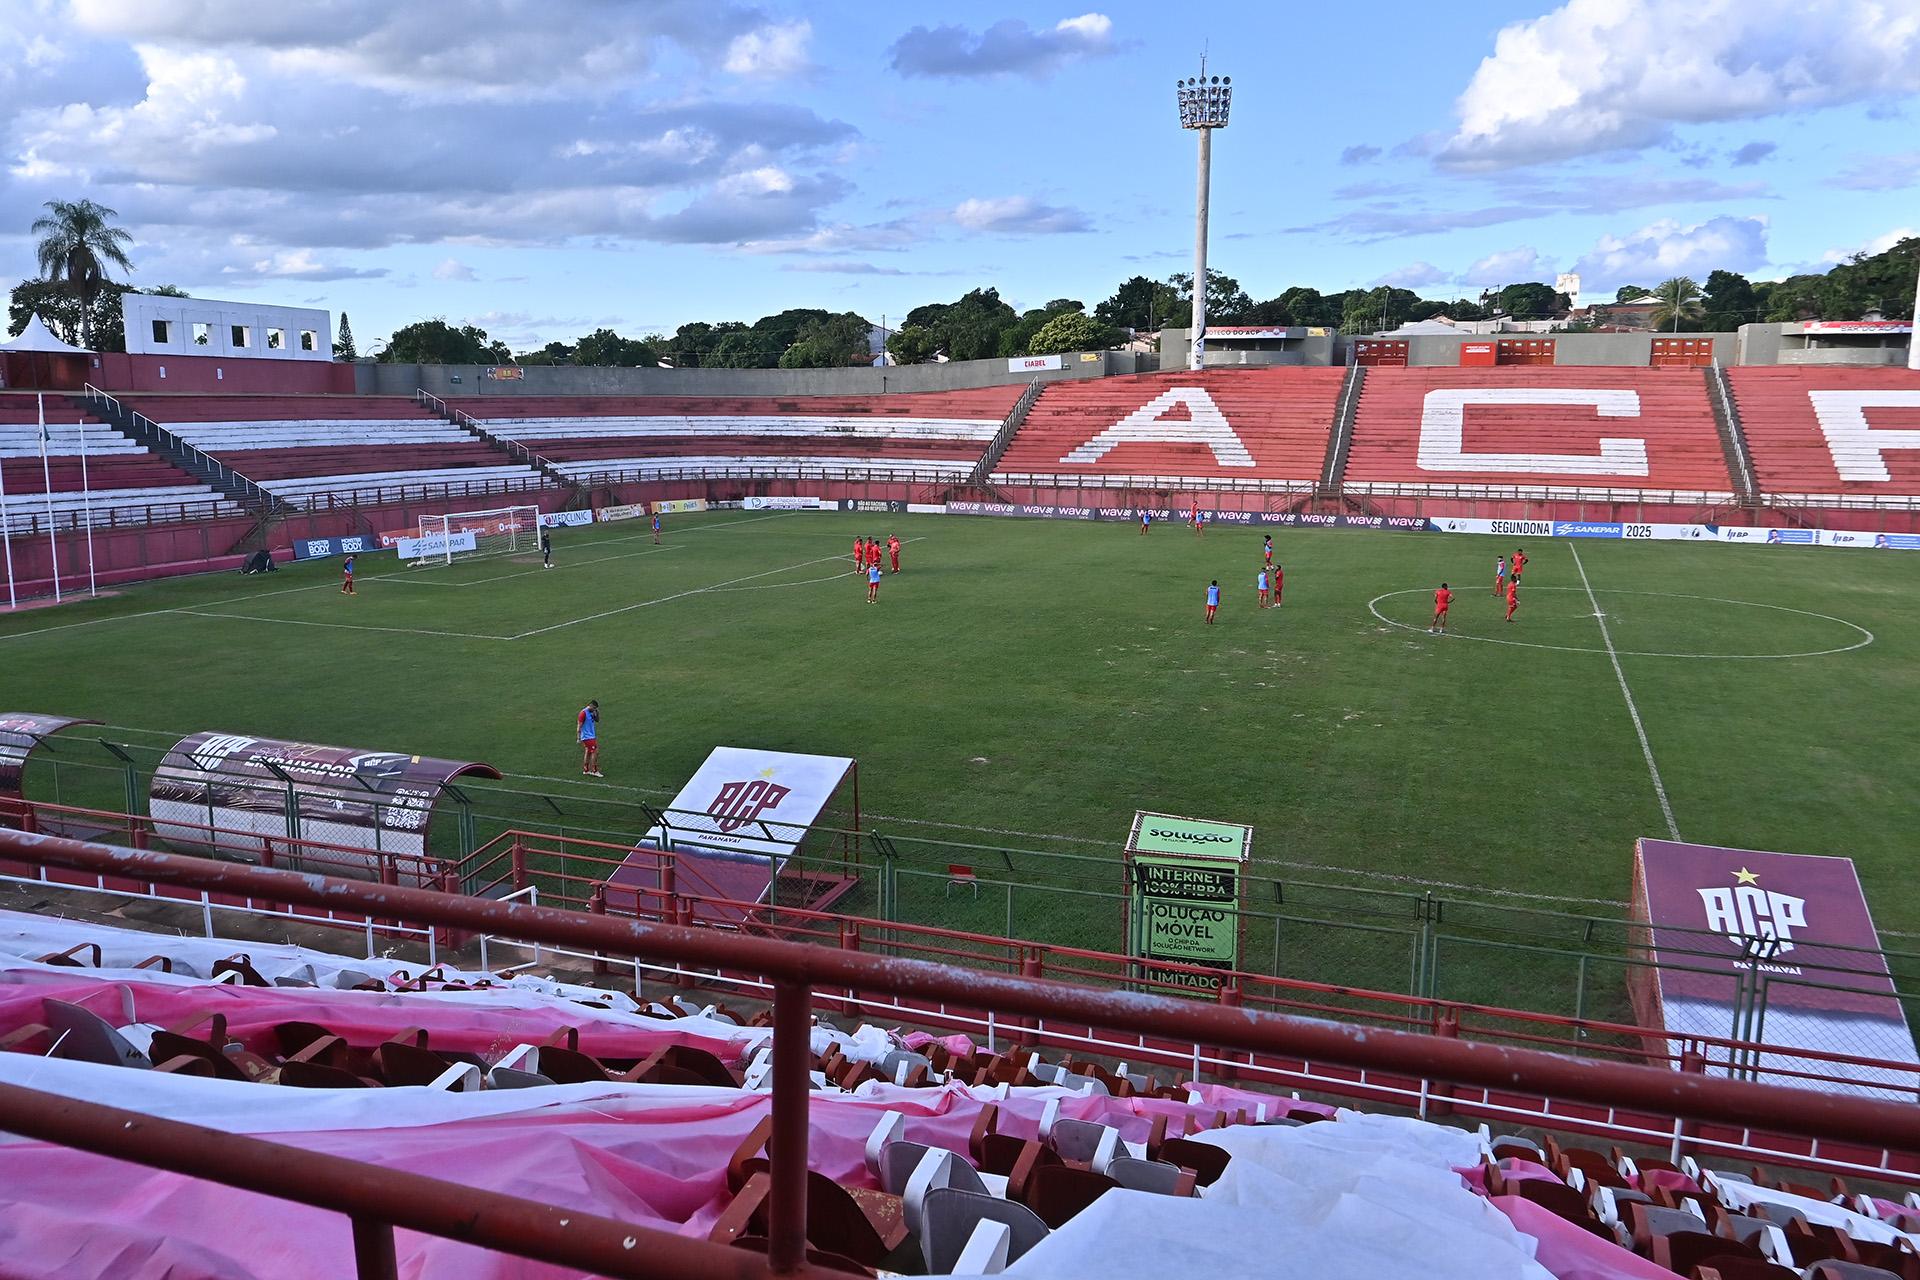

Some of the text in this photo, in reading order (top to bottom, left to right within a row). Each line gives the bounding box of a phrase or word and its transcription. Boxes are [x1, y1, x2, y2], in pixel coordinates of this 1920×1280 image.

[1059, 386, 1258, 469] A
[1417, 388, 1649, 477] C
[552, 511, 589, 523] MEDCLINIC
[1491, 521, 1550, 535] SEGUNDONA
[1626, 525, 1652, 537] 2025
[309, 546, 329, 554] BODY
[343, 543, 362, 551] BODY
[428, 539, 465, 550] SANPAR
[708, 780, 791, 832] ACP
[1697, 886, 1808, 958] ACP
[1155, 920, 1214, 939] MÓVEL
[1153, 941, 1182, 951] SOLUÇÃO
